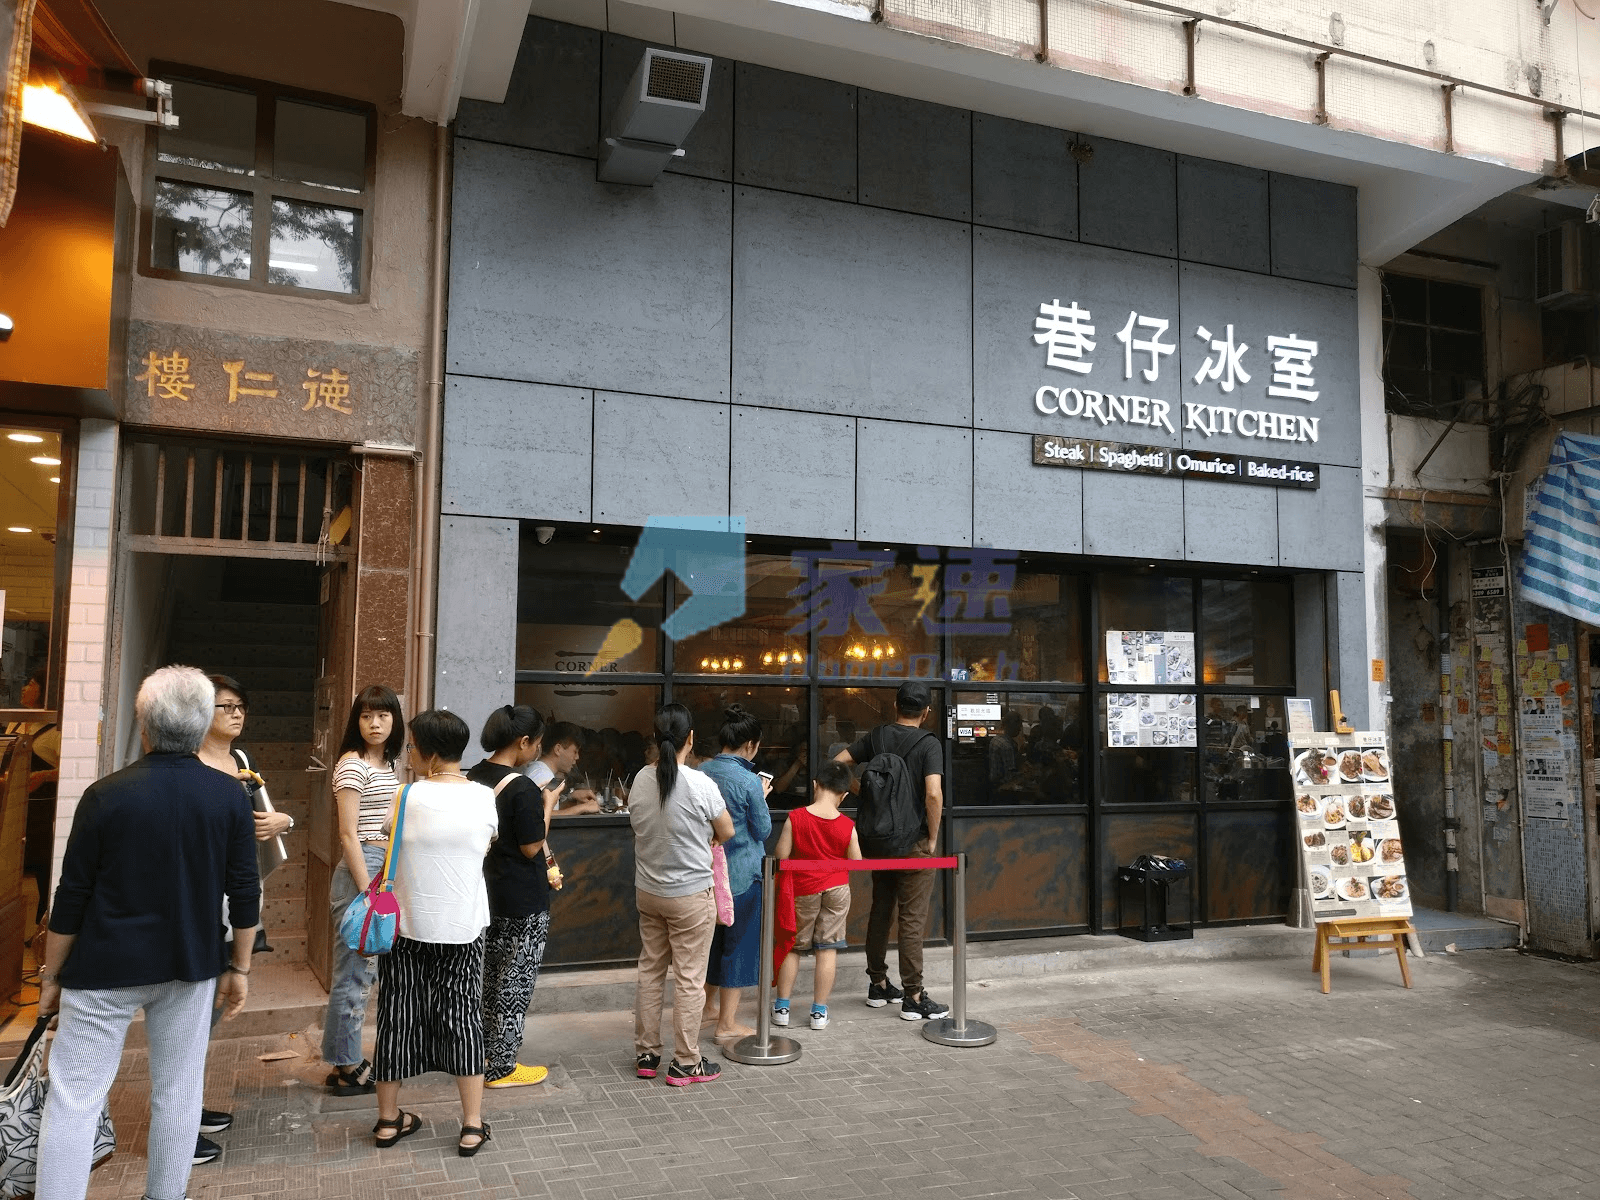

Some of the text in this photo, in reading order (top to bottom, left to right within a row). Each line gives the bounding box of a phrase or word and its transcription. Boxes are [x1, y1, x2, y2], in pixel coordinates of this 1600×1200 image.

[1033, 299, 1320, 402] 巷仔冰室
[1035, 385, 1320, 443] CORNER KITCHEN
[1044, 441, 1315, 483] Steak Spaghetti Omurice Baked-rice
